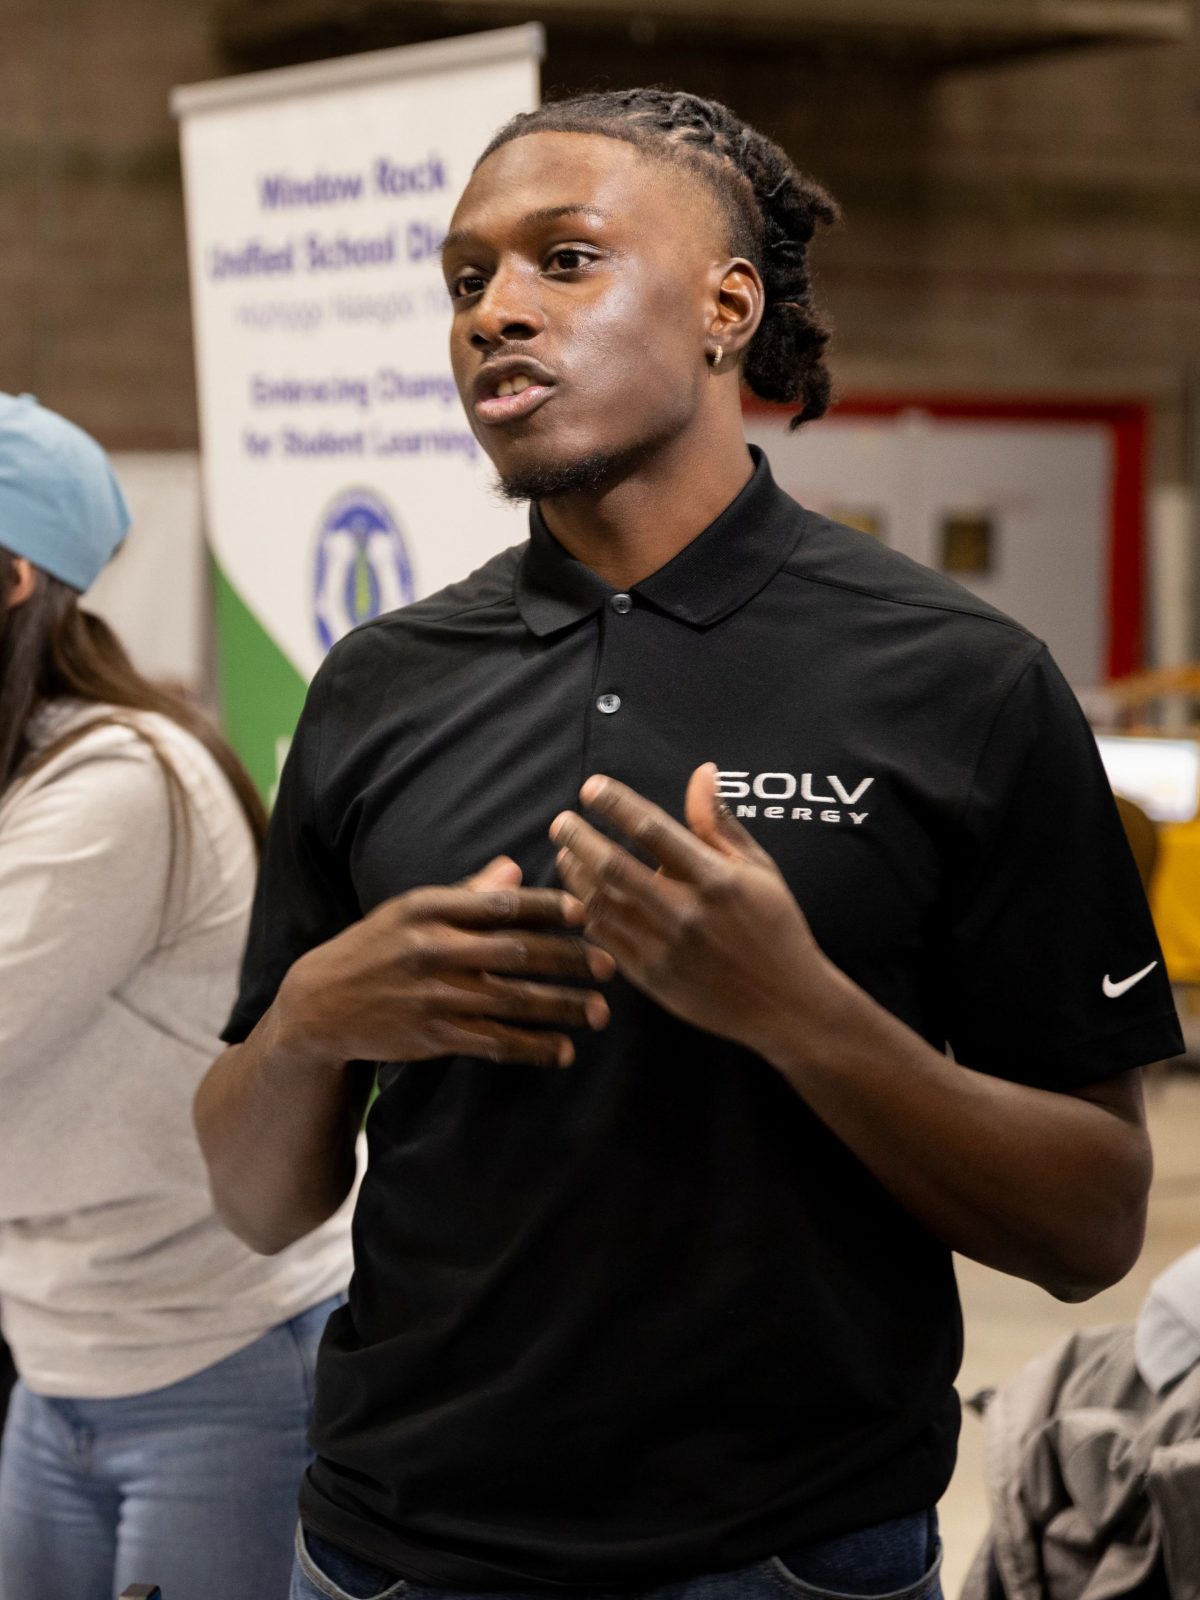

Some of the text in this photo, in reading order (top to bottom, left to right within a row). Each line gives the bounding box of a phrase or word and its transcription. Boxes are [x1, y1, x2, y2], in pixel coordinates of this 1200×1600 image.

[260, 154, 446, 210] Window Rock
[210, 242, 294, 280] Unified
[306, 232, 397, 270] School
[250, 368, 459, 409] Embracing Chang
[244, 425, 479, 461] for Student Learning
[714, 771, 875, 805] SOLV
[719, 804, 869, 825] NERGY
